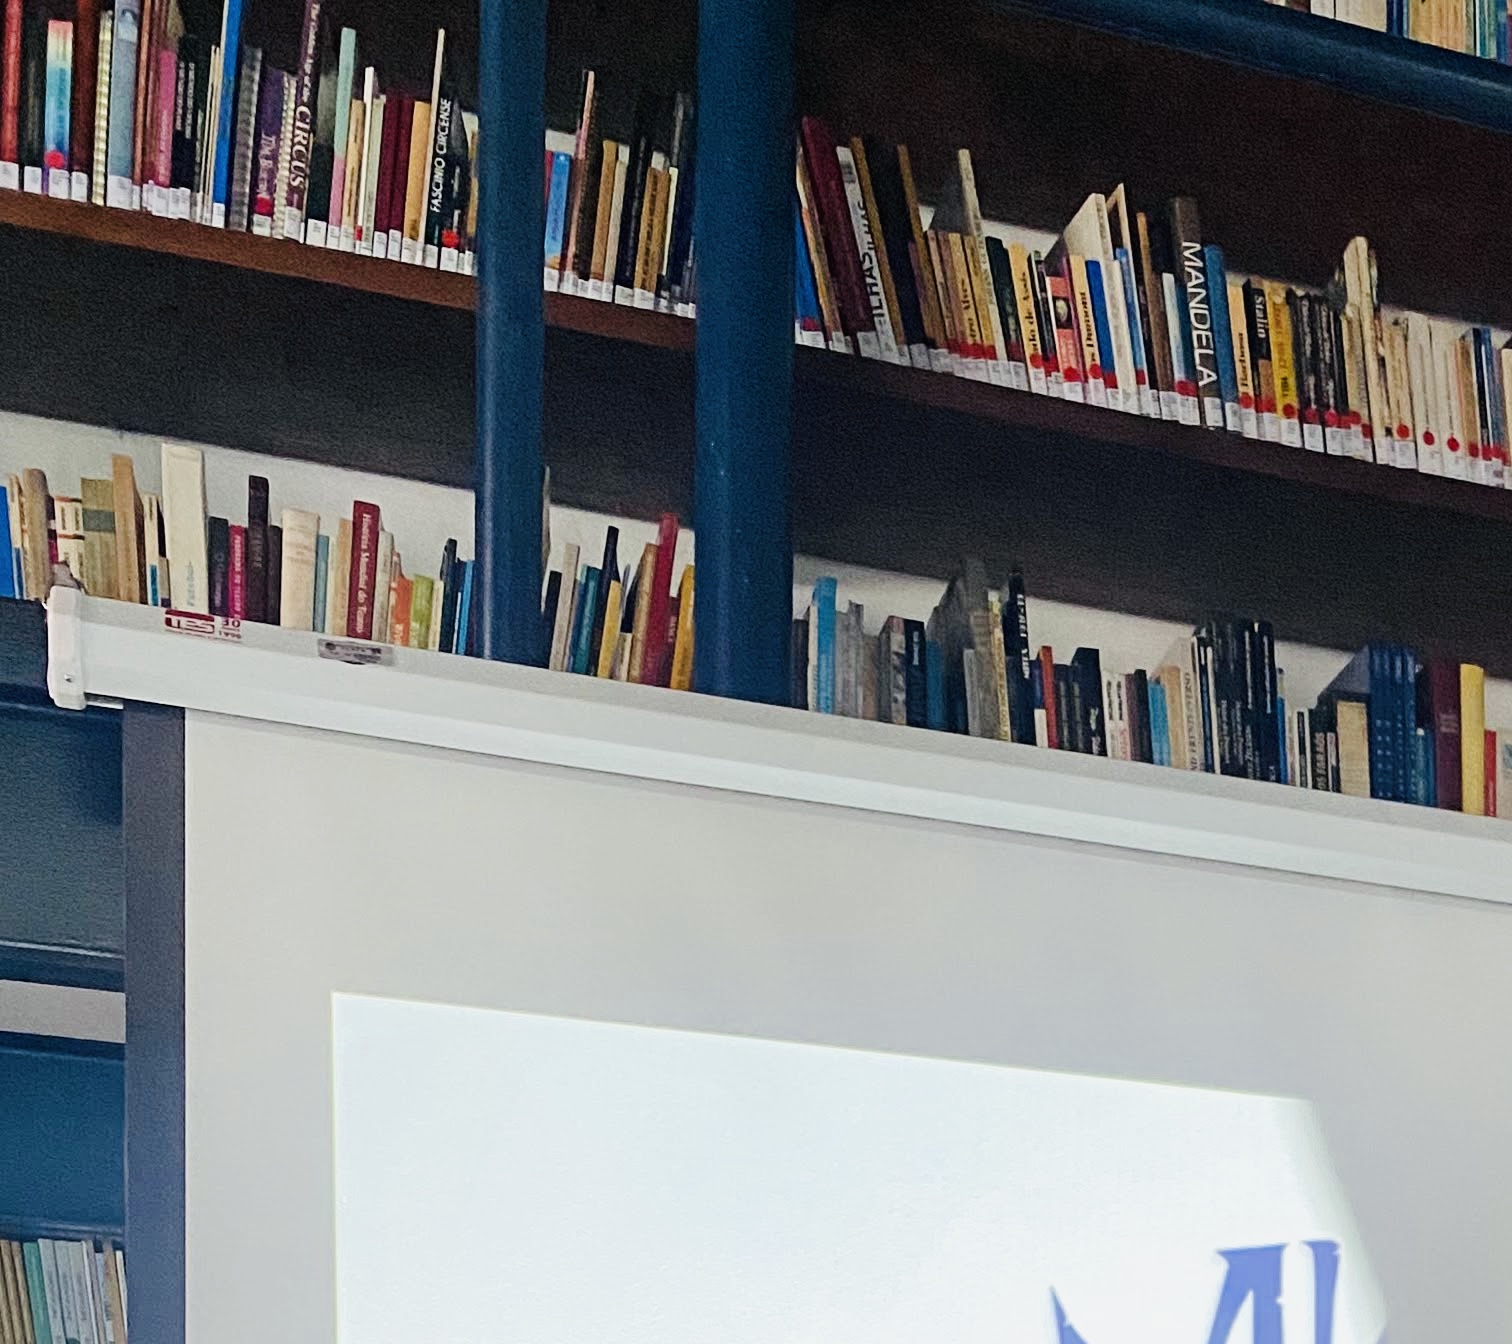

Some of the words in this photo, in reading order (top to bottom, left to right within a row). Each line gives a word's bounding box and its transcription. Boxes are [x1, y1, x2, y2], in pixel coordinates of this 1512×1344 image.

[289, 104, 313, 188] CIRCUS
[435, 97, 451, 157] CIRCENSE
[1182, 241, 1217, 387] MANDELA
[1254, 295, 1268, 339] Stalin
